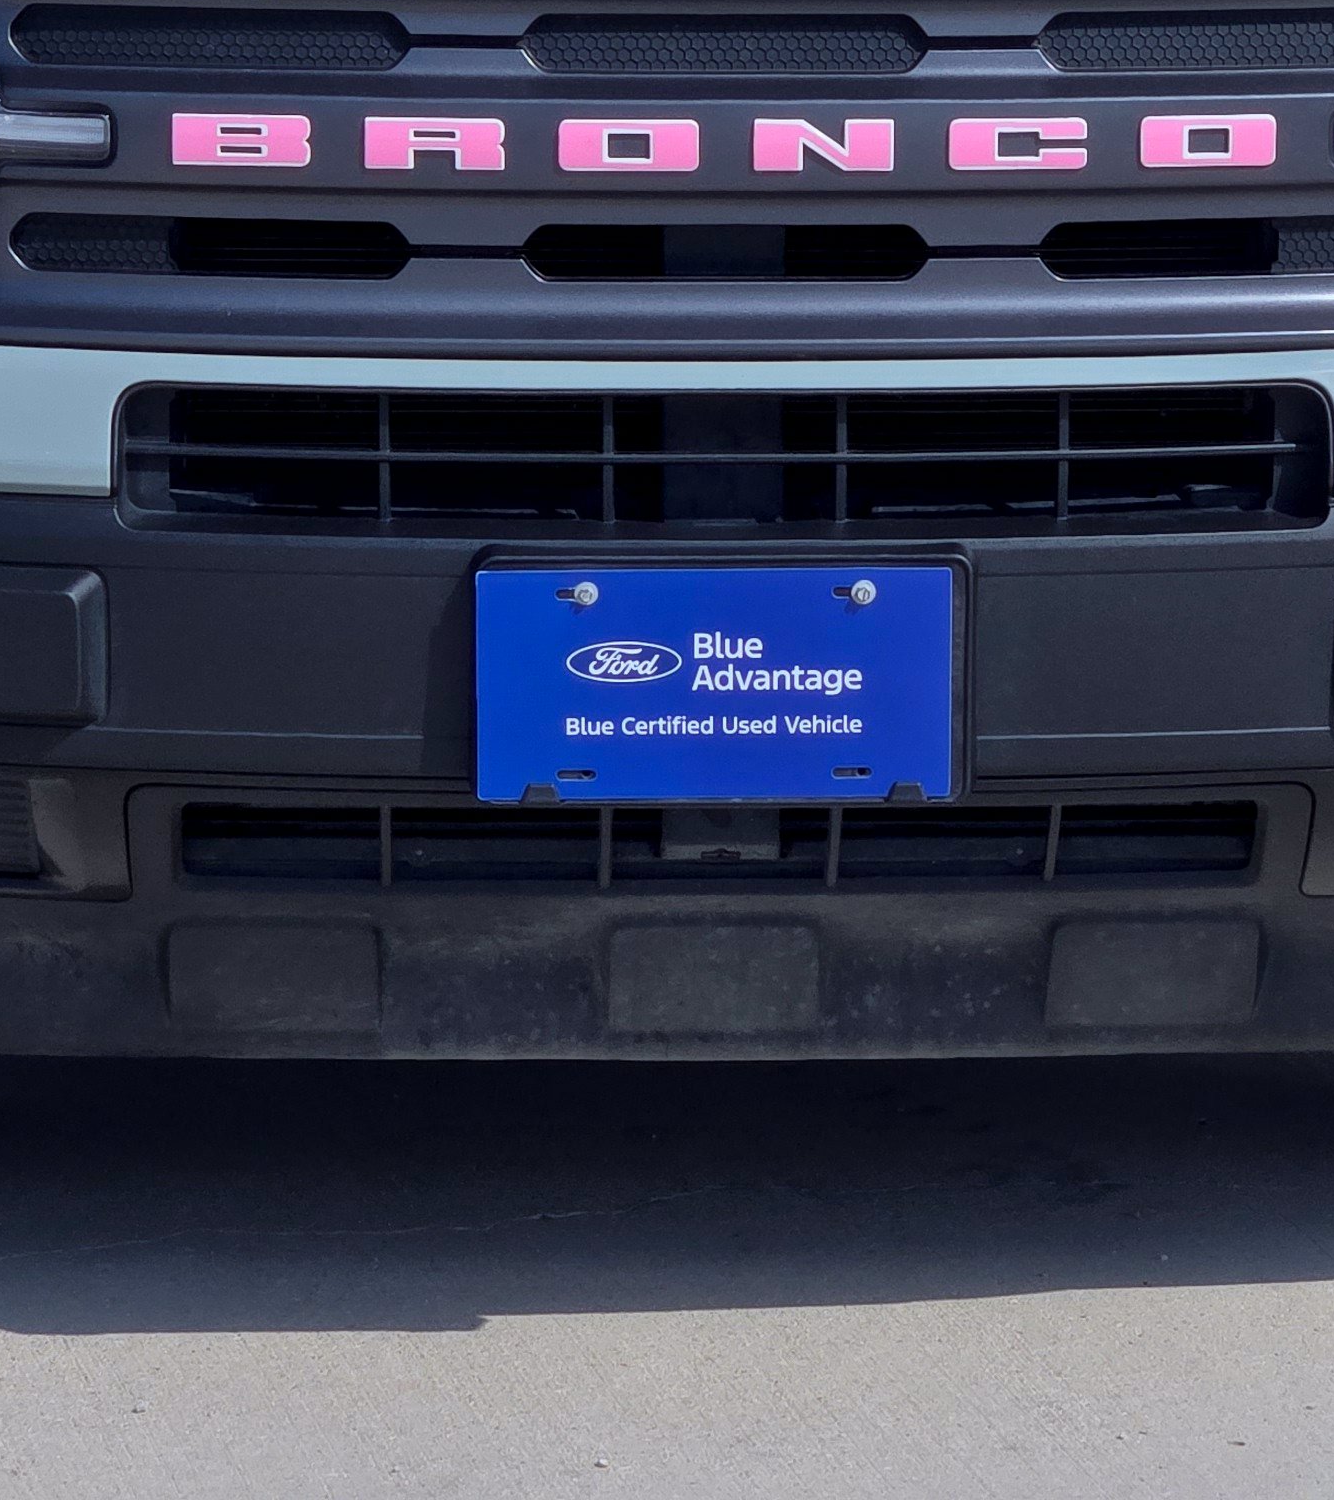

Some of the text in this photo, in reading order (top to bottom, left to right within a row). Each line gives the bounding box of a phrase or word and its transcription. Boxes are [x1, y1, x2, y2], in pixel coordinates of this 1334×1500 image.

[171, 113, 1278, 173] BRONCO
[693, 631, 764, 660] Blue
[587, 646, 661, 676] Ford
[691, 663, 864, 696] Advantage
[565, 714, 864, 736] Blue Certified Used Vehicle
